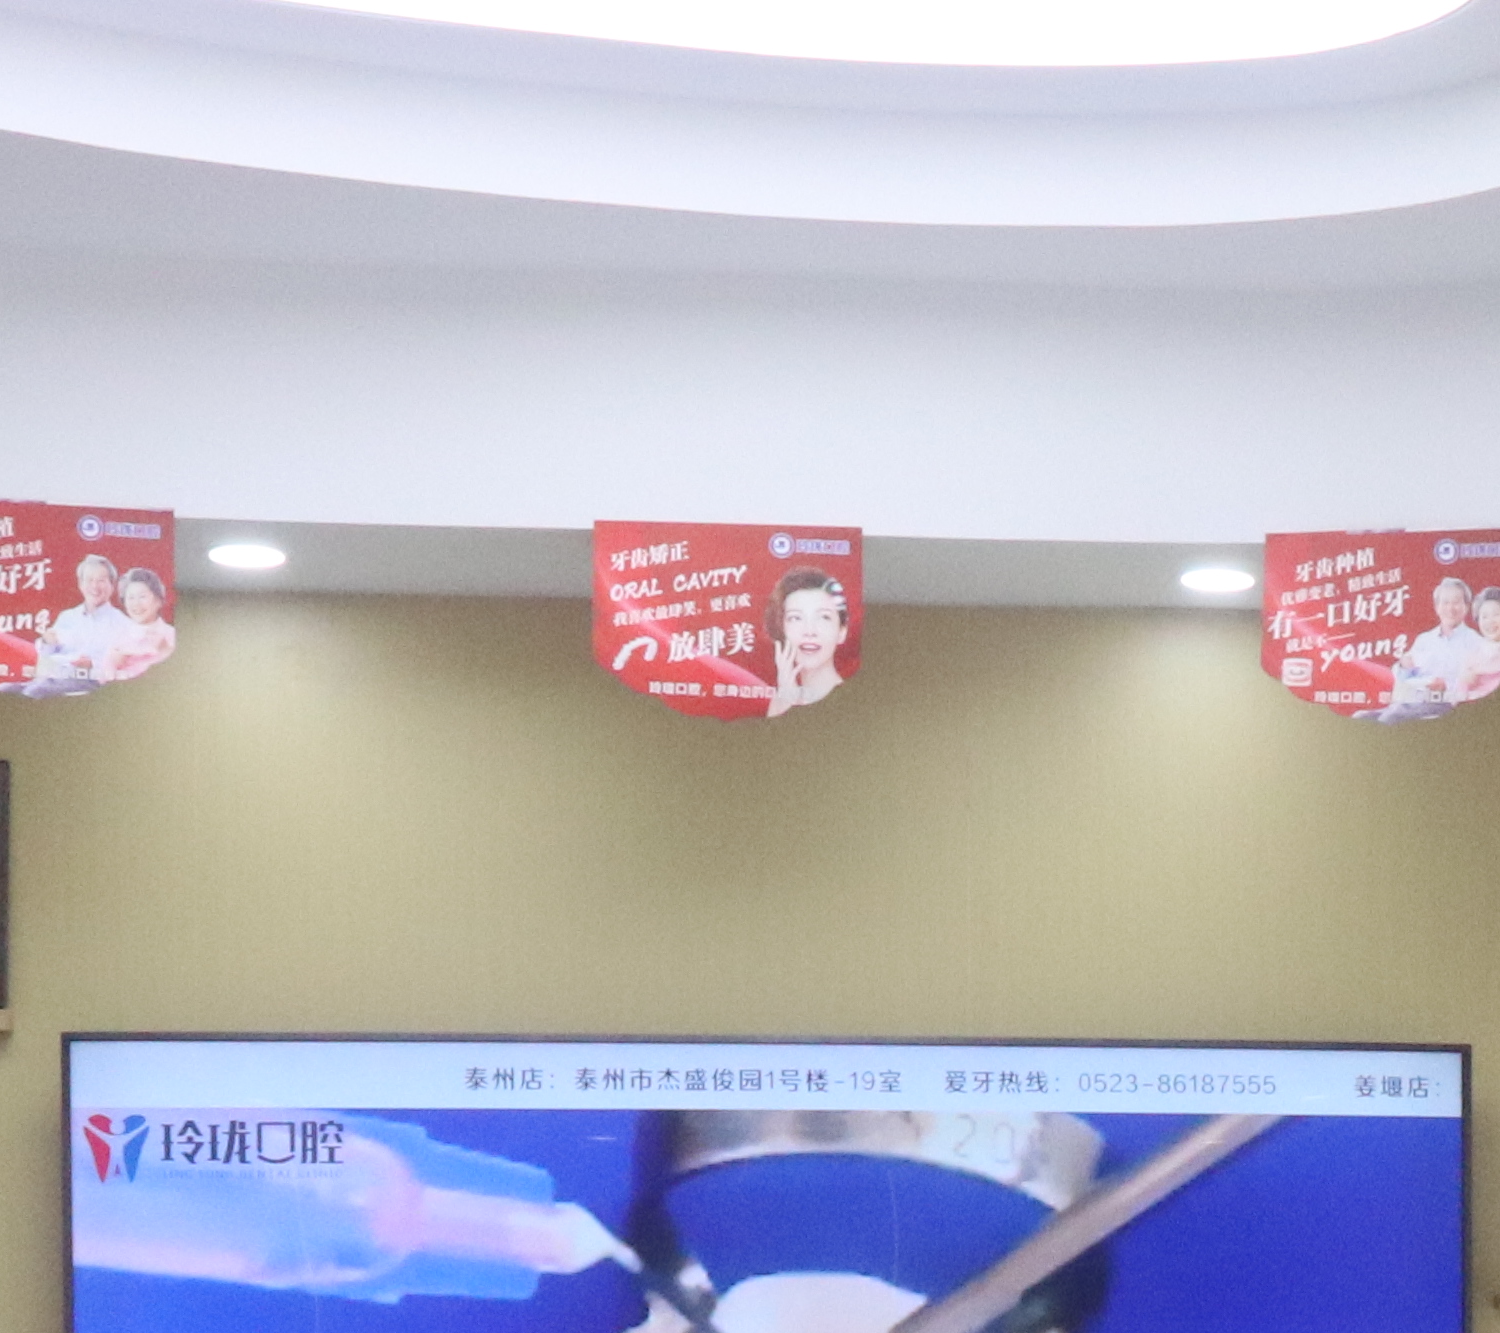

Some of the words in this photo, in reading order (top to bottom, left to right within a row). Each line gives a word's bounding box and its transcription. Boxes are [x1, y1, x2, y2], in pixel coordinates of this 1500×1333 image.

[610, 540, 690, 572] 牙齿矫正
[1295, 547, 1376, 583] 牙齿种植
[610, 578, 664, 602] ORAL
[673, 564, 748, 592] CAVITY
[1267, 585, 1411, 640] 有一口好牙
[667, 622, 756, 663] 放肆美
[1320, 634, 1408, 672] young
[160, 1119, 344, 1165] 玲珑口腔
